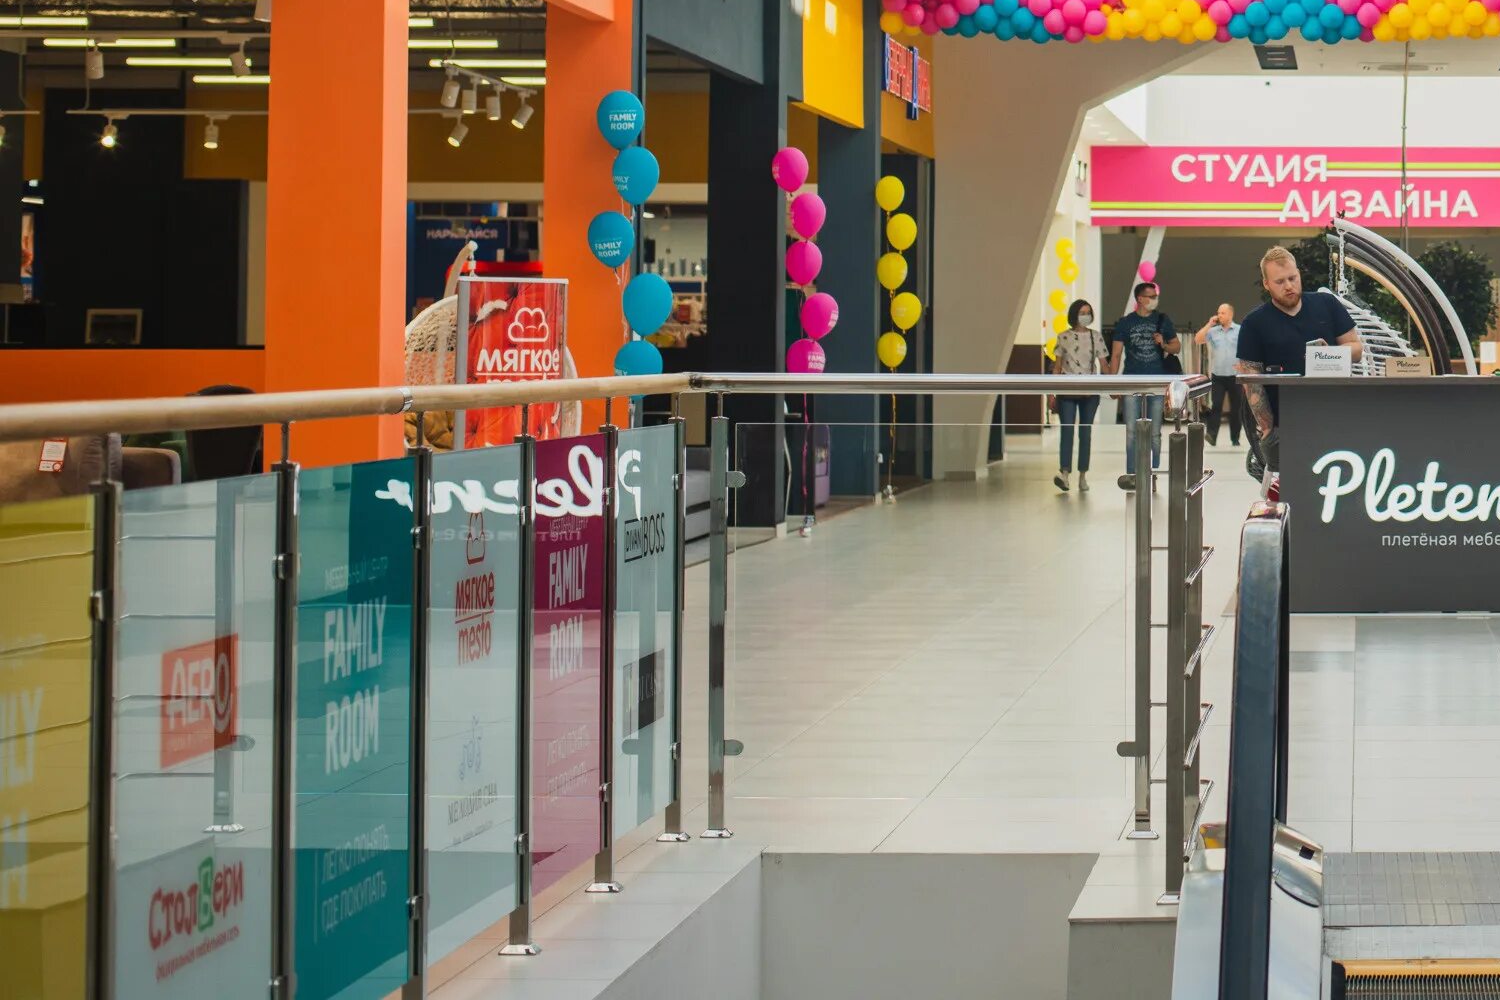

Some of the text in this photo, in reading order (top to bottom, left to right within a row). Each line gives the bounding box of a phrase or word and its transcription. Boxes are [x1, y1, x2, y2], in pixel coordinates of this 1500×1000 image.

[609, 113, 637, 122] FAMILY
[610, 122, 634, 130] ROOM
[1171, 154, 1327, 188] СТУДИЯ
[1279, 184, 1479, 223] ДИЗАЙНА
[594, 241, 622, 251] FAMILY
[599, 250, 620, 258] ROOM
[1314, 352, 1342, 360] Pletenev
[643, 512, 665, 557] BOSS
[1382, 532, 1456, 547] плетёная
[549, 544, 588, 609] FAMILY
[323, 596, 387, 683] FAMILY
[458, 612, 491, 666] mesto
[551, 614, 583, 681] ROOM
[167, 652, 231, 733] AERO
[325, 684, 380, 776] ROOM
